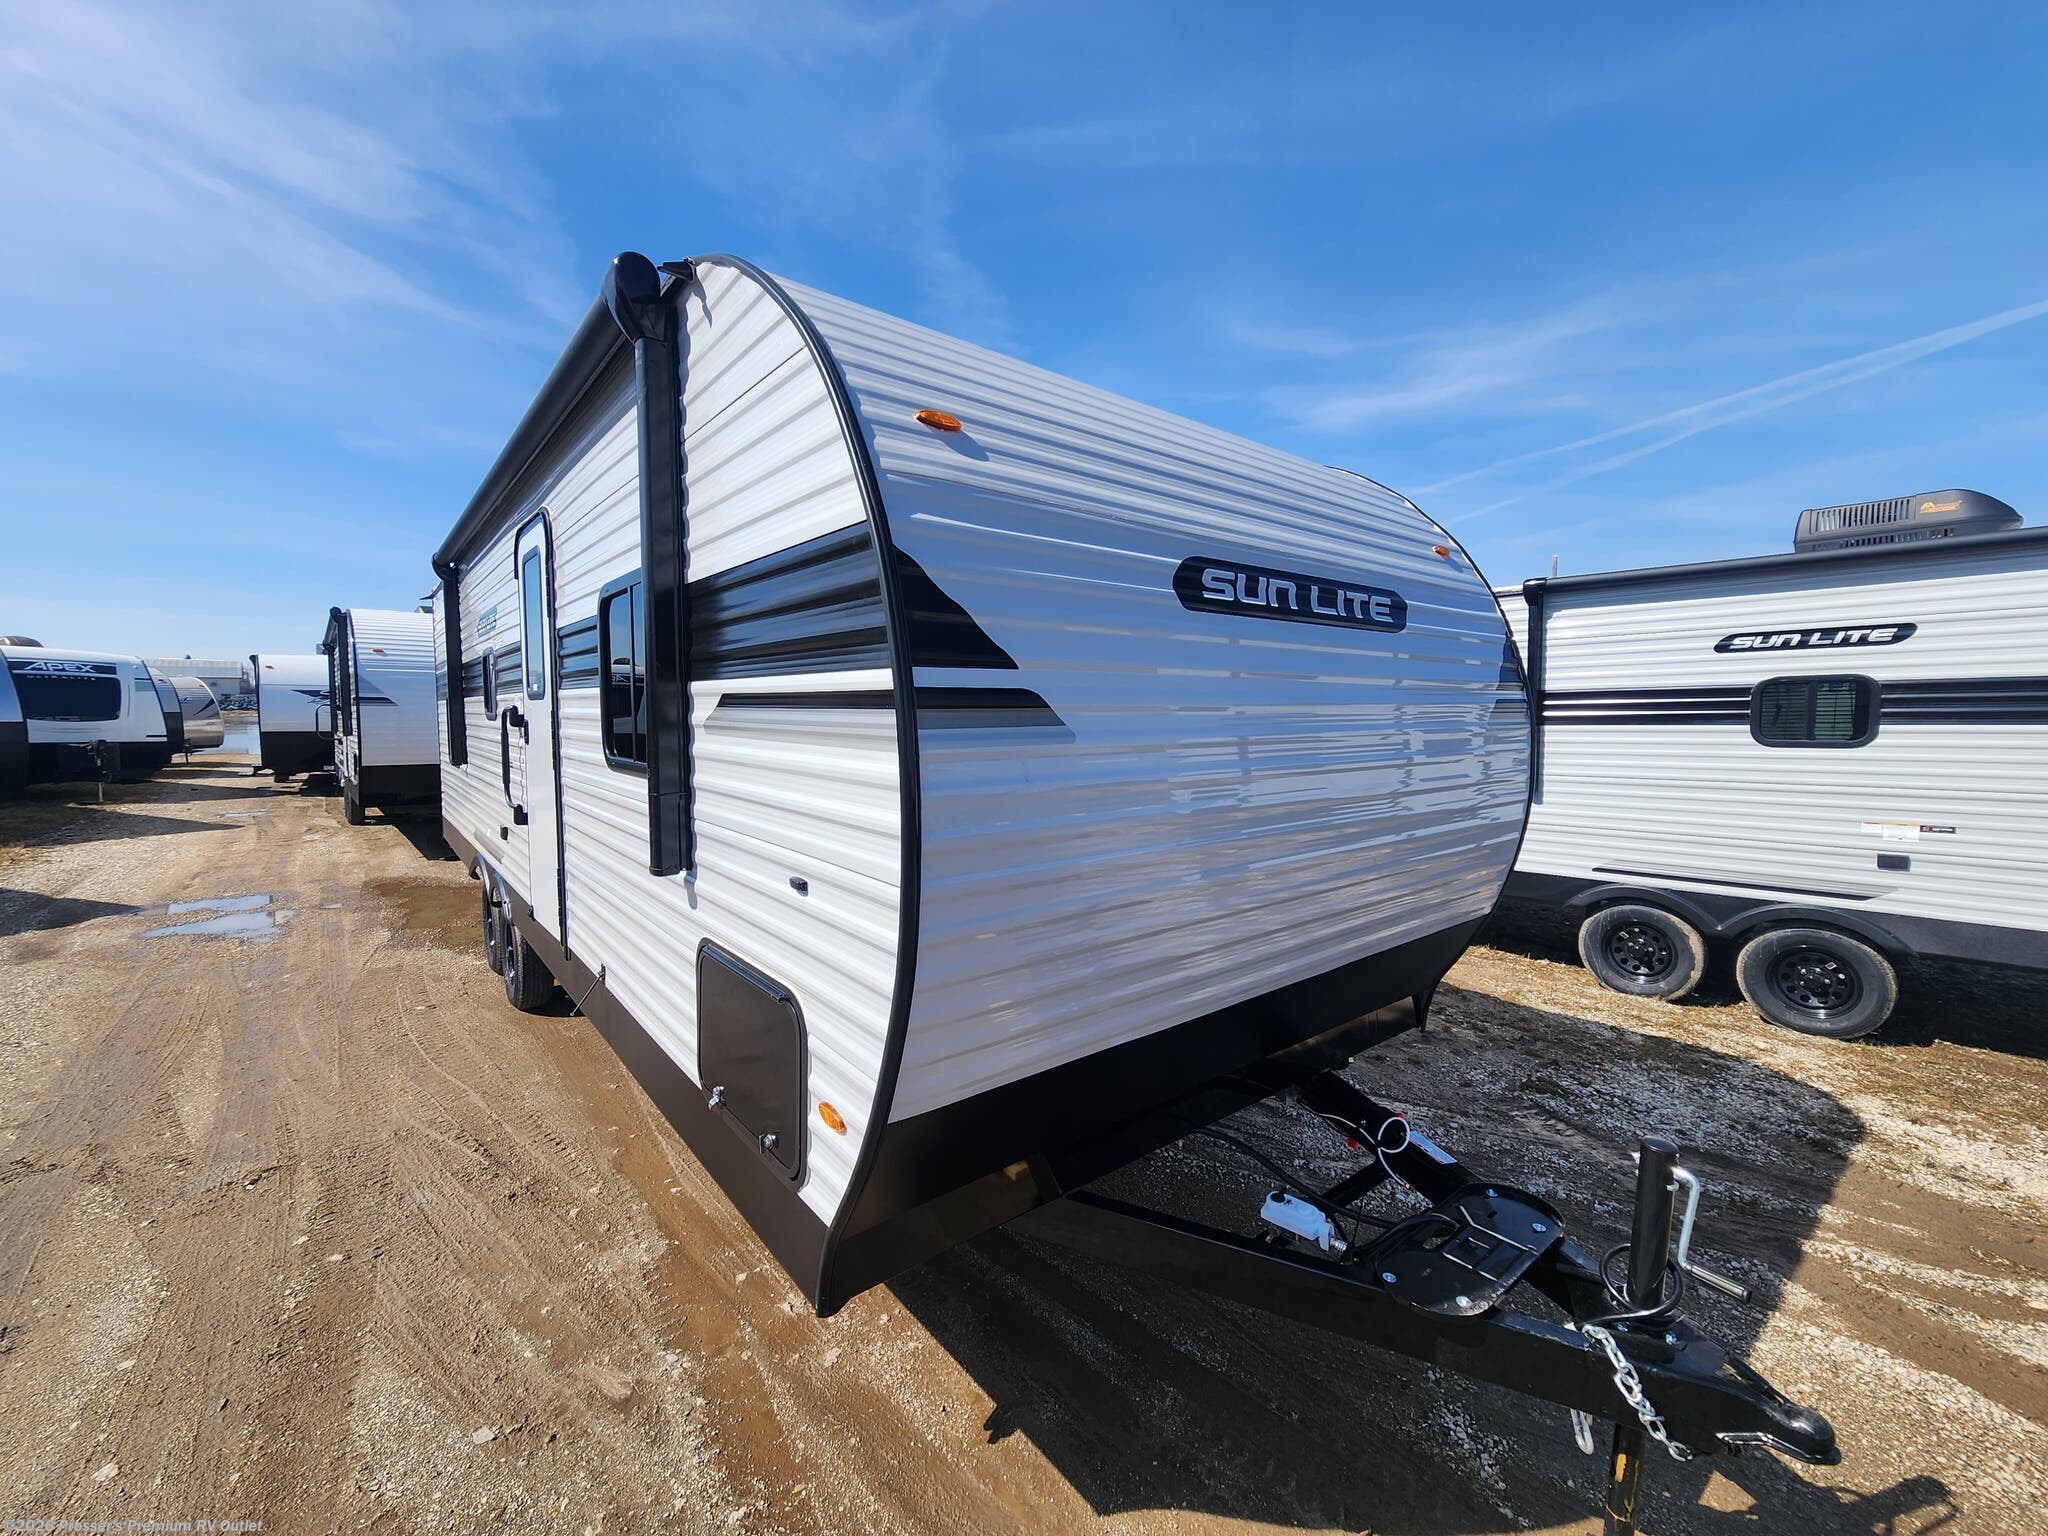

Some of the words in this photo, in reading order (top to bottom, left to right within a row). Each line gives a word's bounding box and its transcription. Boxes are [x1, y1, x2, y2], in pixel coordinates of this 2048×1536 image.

[1201, 568, 1298, 610] SUN
[1310, 585, 1394, 623] LITE
[1729, 632, 1802, 650] SUN
[1807, 626, 1898, 645] LITE
[24, 661, 97, 673] APEX
